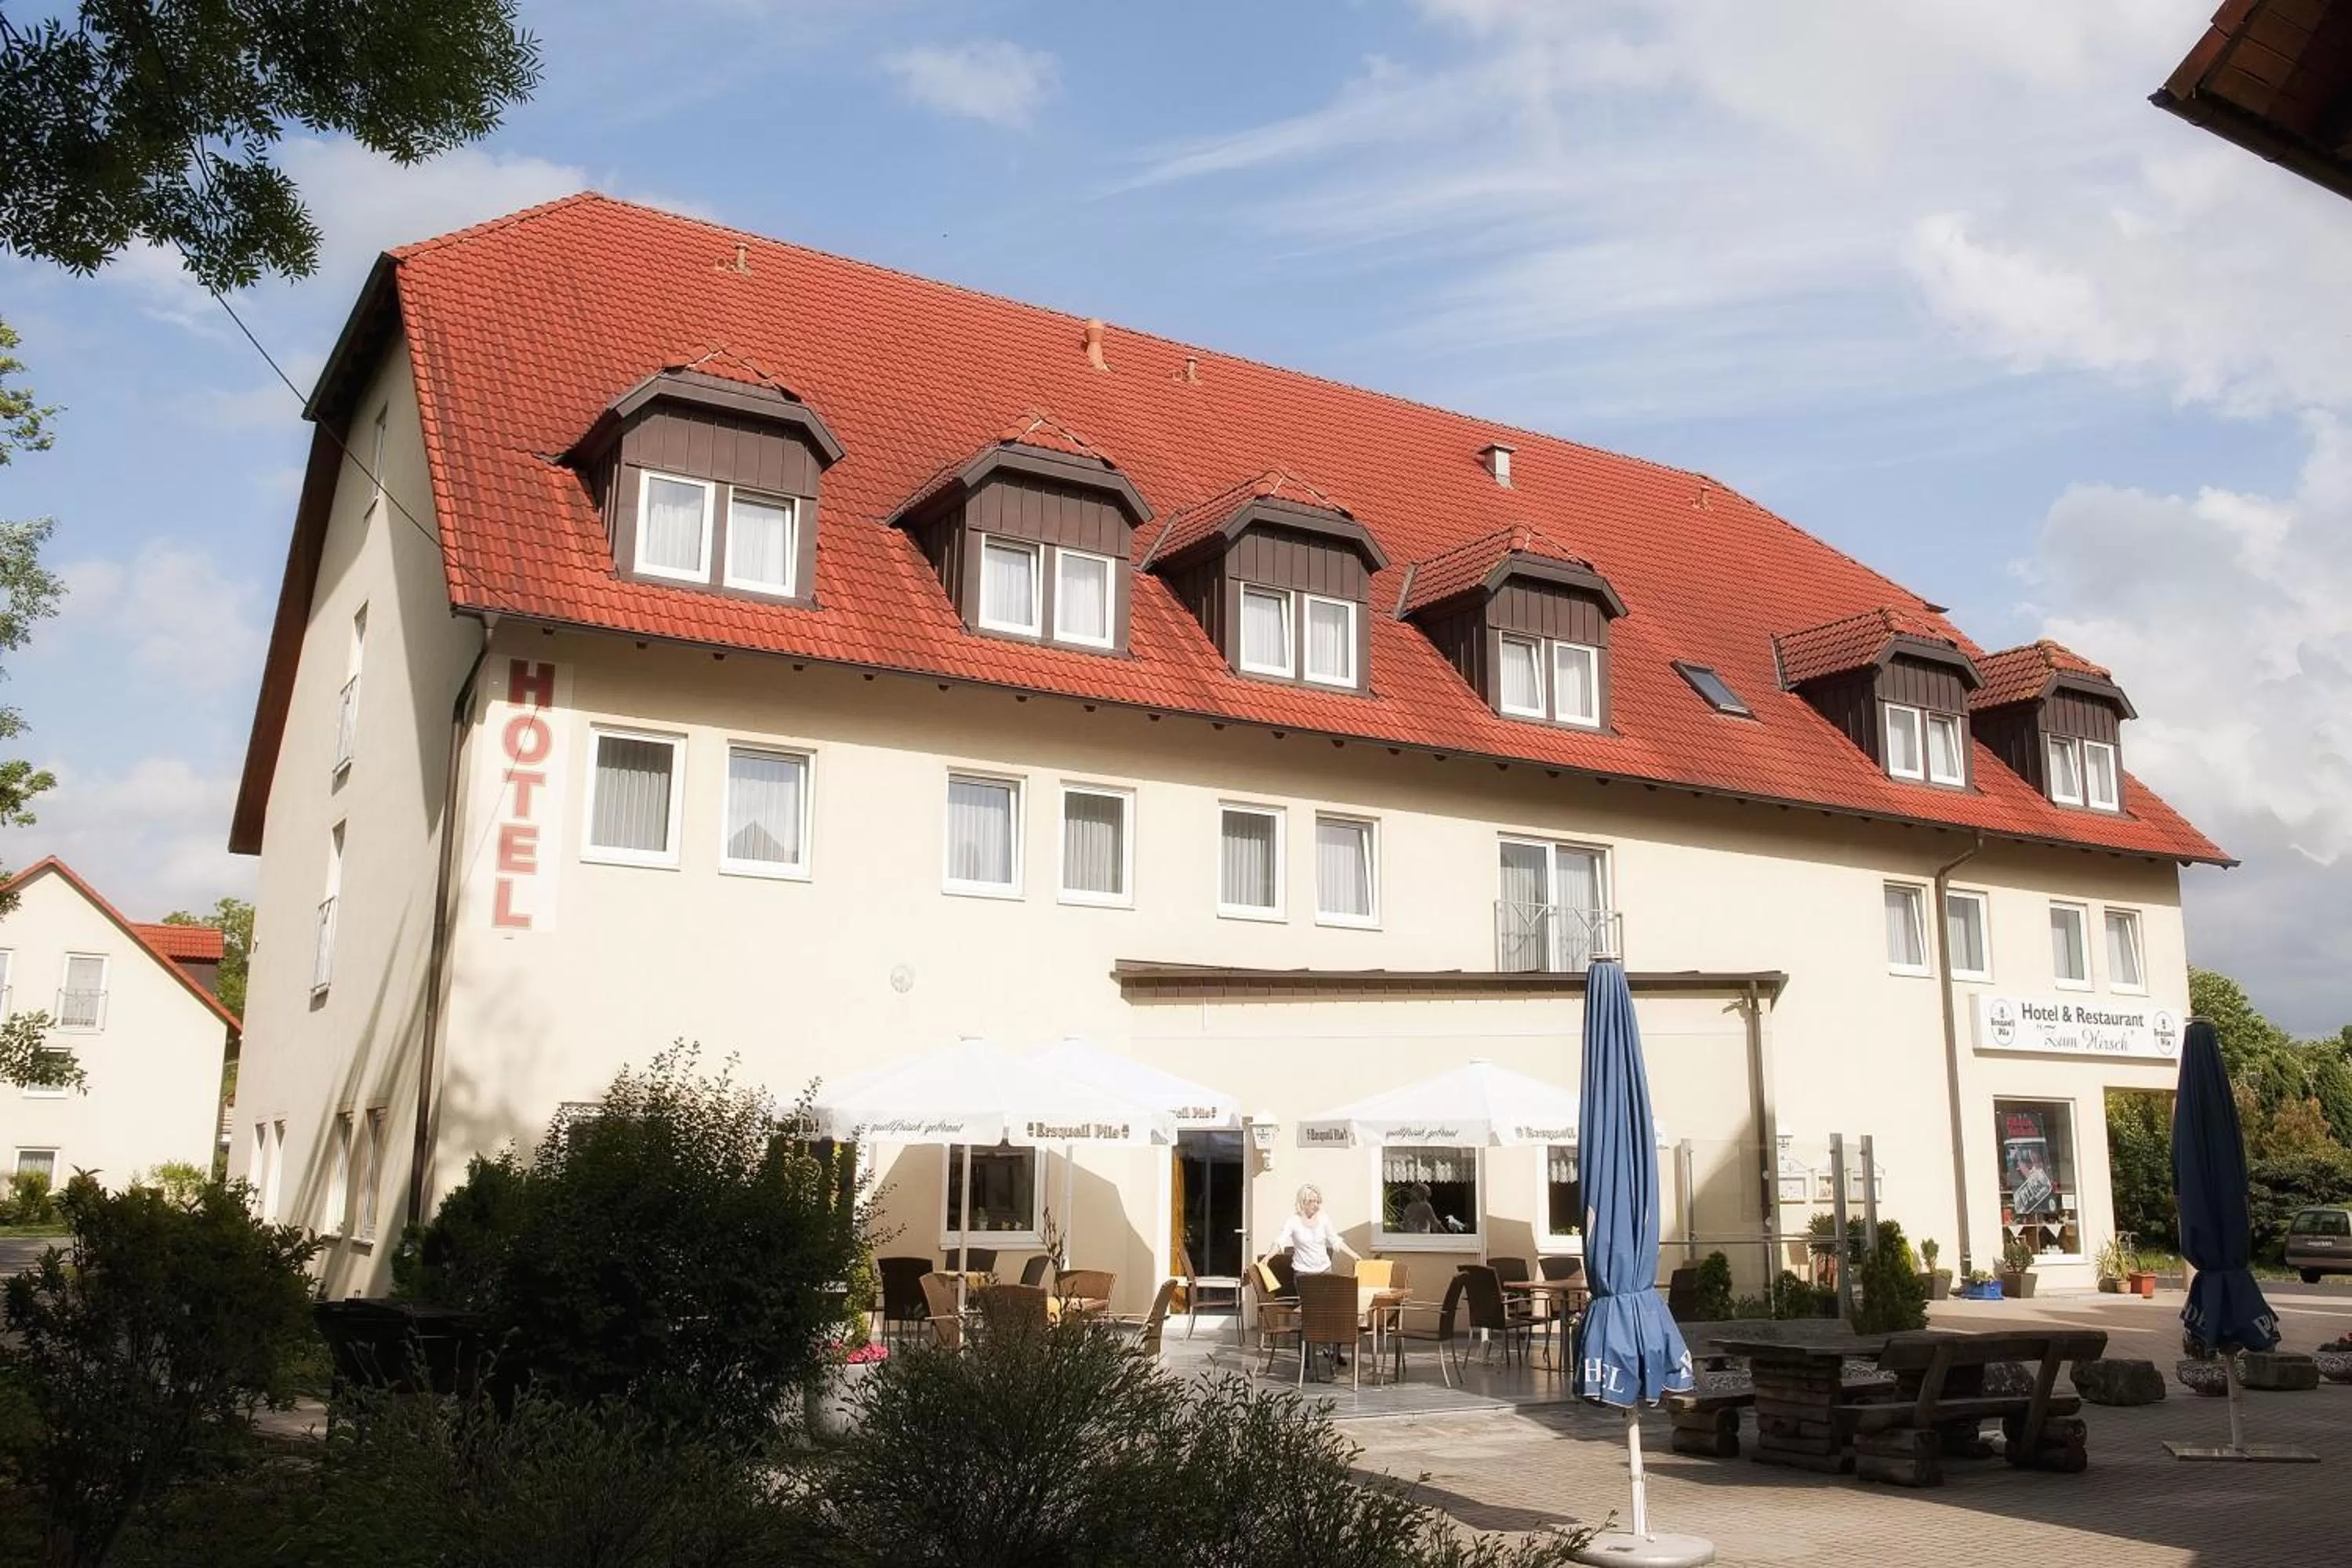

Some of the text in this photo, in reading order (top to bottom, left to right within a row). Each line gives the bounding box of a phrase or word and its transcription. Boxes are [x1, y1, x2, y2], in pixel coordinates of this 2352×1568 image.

[492, 658, 556, 930] HOTEL
[2022, 1003, 2144, 1027] Hotel & Restaurant
